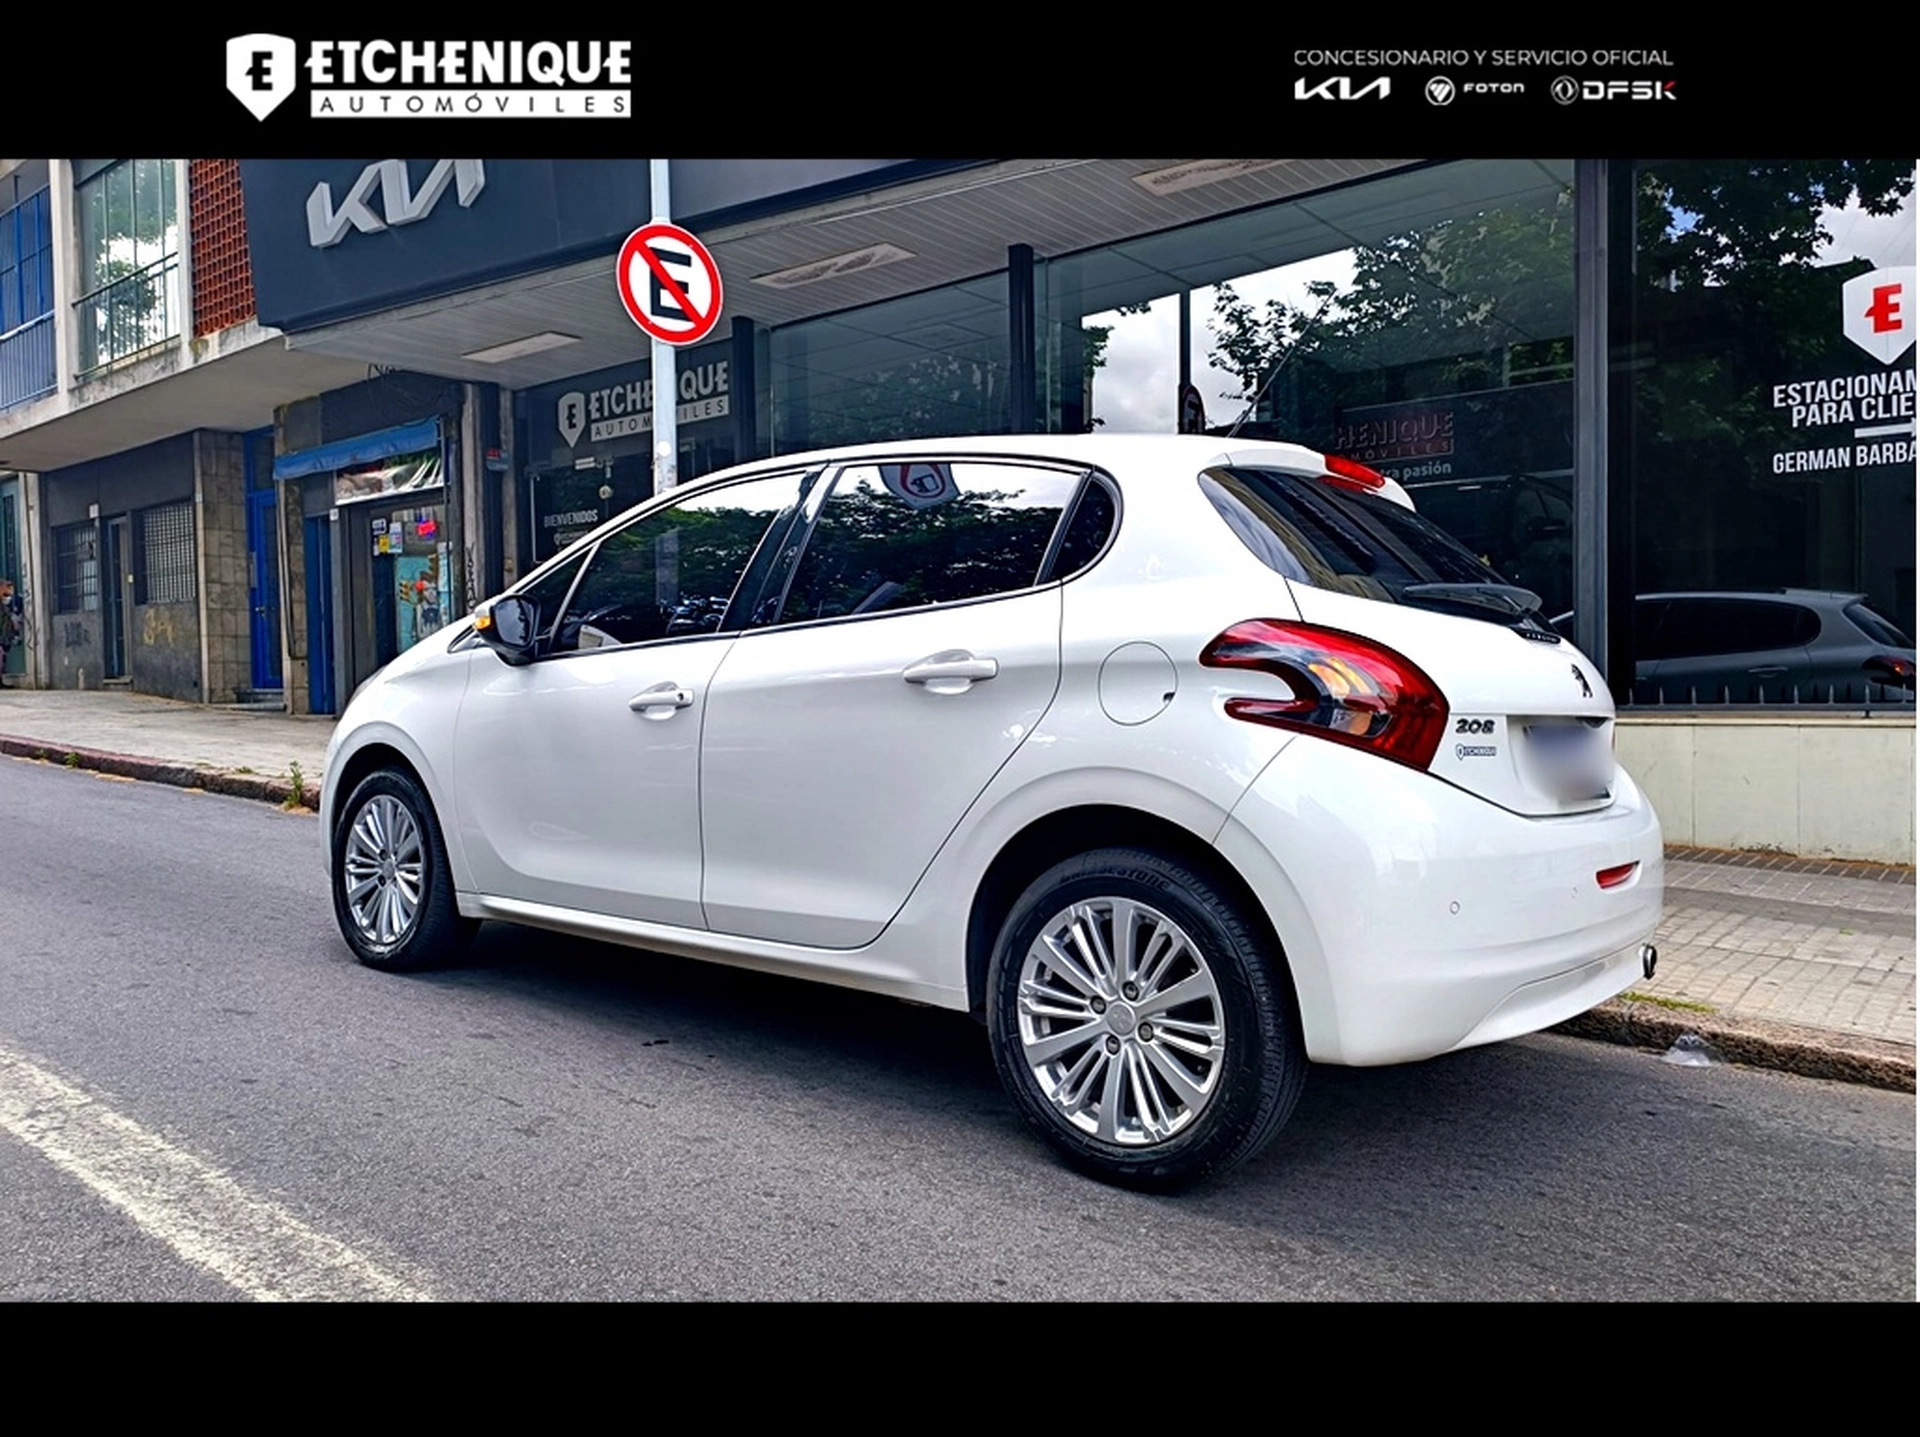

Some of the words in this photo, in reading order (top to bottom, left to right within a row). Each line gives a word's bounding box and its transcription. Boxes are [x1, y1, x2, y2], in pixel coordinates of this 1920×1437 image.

[649, 246, 694, 322] E
[1864, 283, 1903, 333] E
[588, 360, 729, 420] ETCHEQUE
[594, 399, 725, 438] AUTOMILES
[1791, 400, 1855, 428] PARA
[1861, 392, 1915, 421] CLIE
[1403, 460, 1452, 482] pasión
[1772, 446, 1851, 475] GERMAN
[1455, 718, 1496, 735] 208
